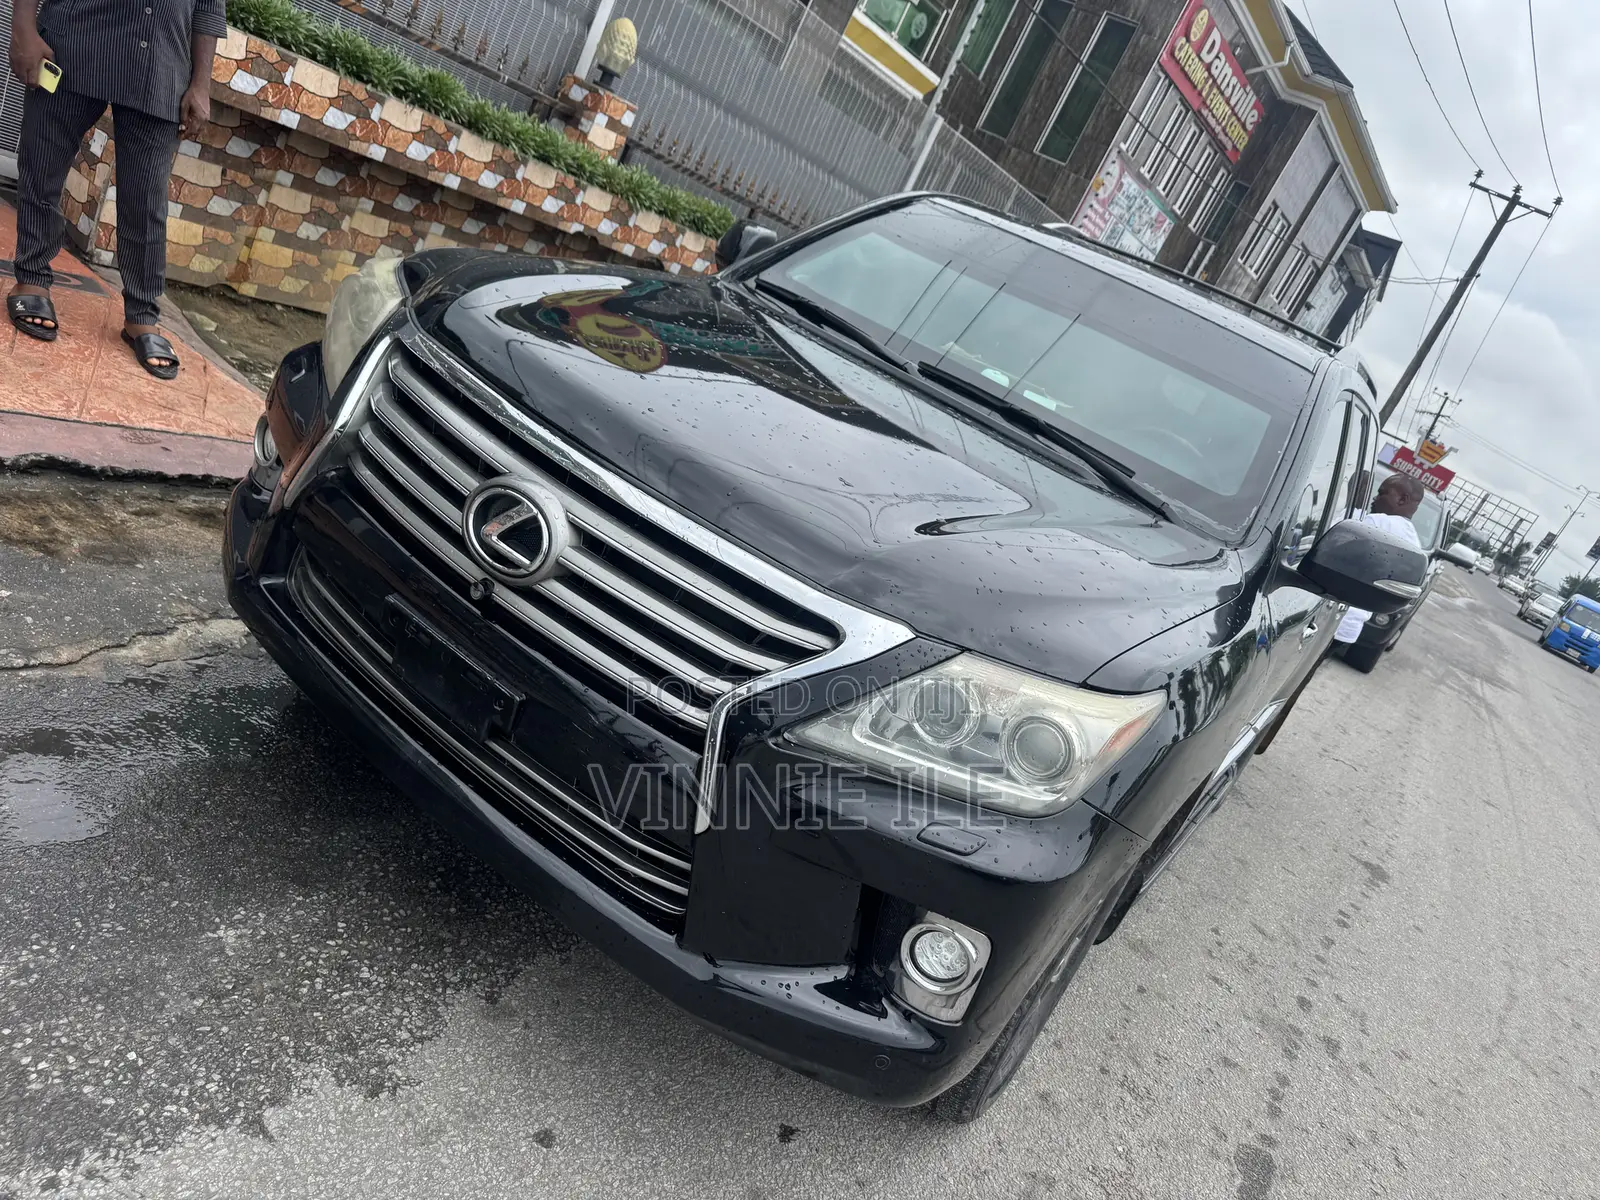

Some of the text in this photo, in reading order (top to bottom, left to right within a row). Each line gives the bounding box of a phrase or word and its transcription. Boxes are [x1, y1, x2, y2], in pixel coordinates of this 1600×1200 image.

[1174, 36, 1209, 90] CATERING
[1206, 87, 1232, 127] EVENTS
[1226, 115, 1249, 152] CENTER
[1200, 26, 1258, 131] Dansville
[1393, 458, 1445, 489] SUPER CITY
